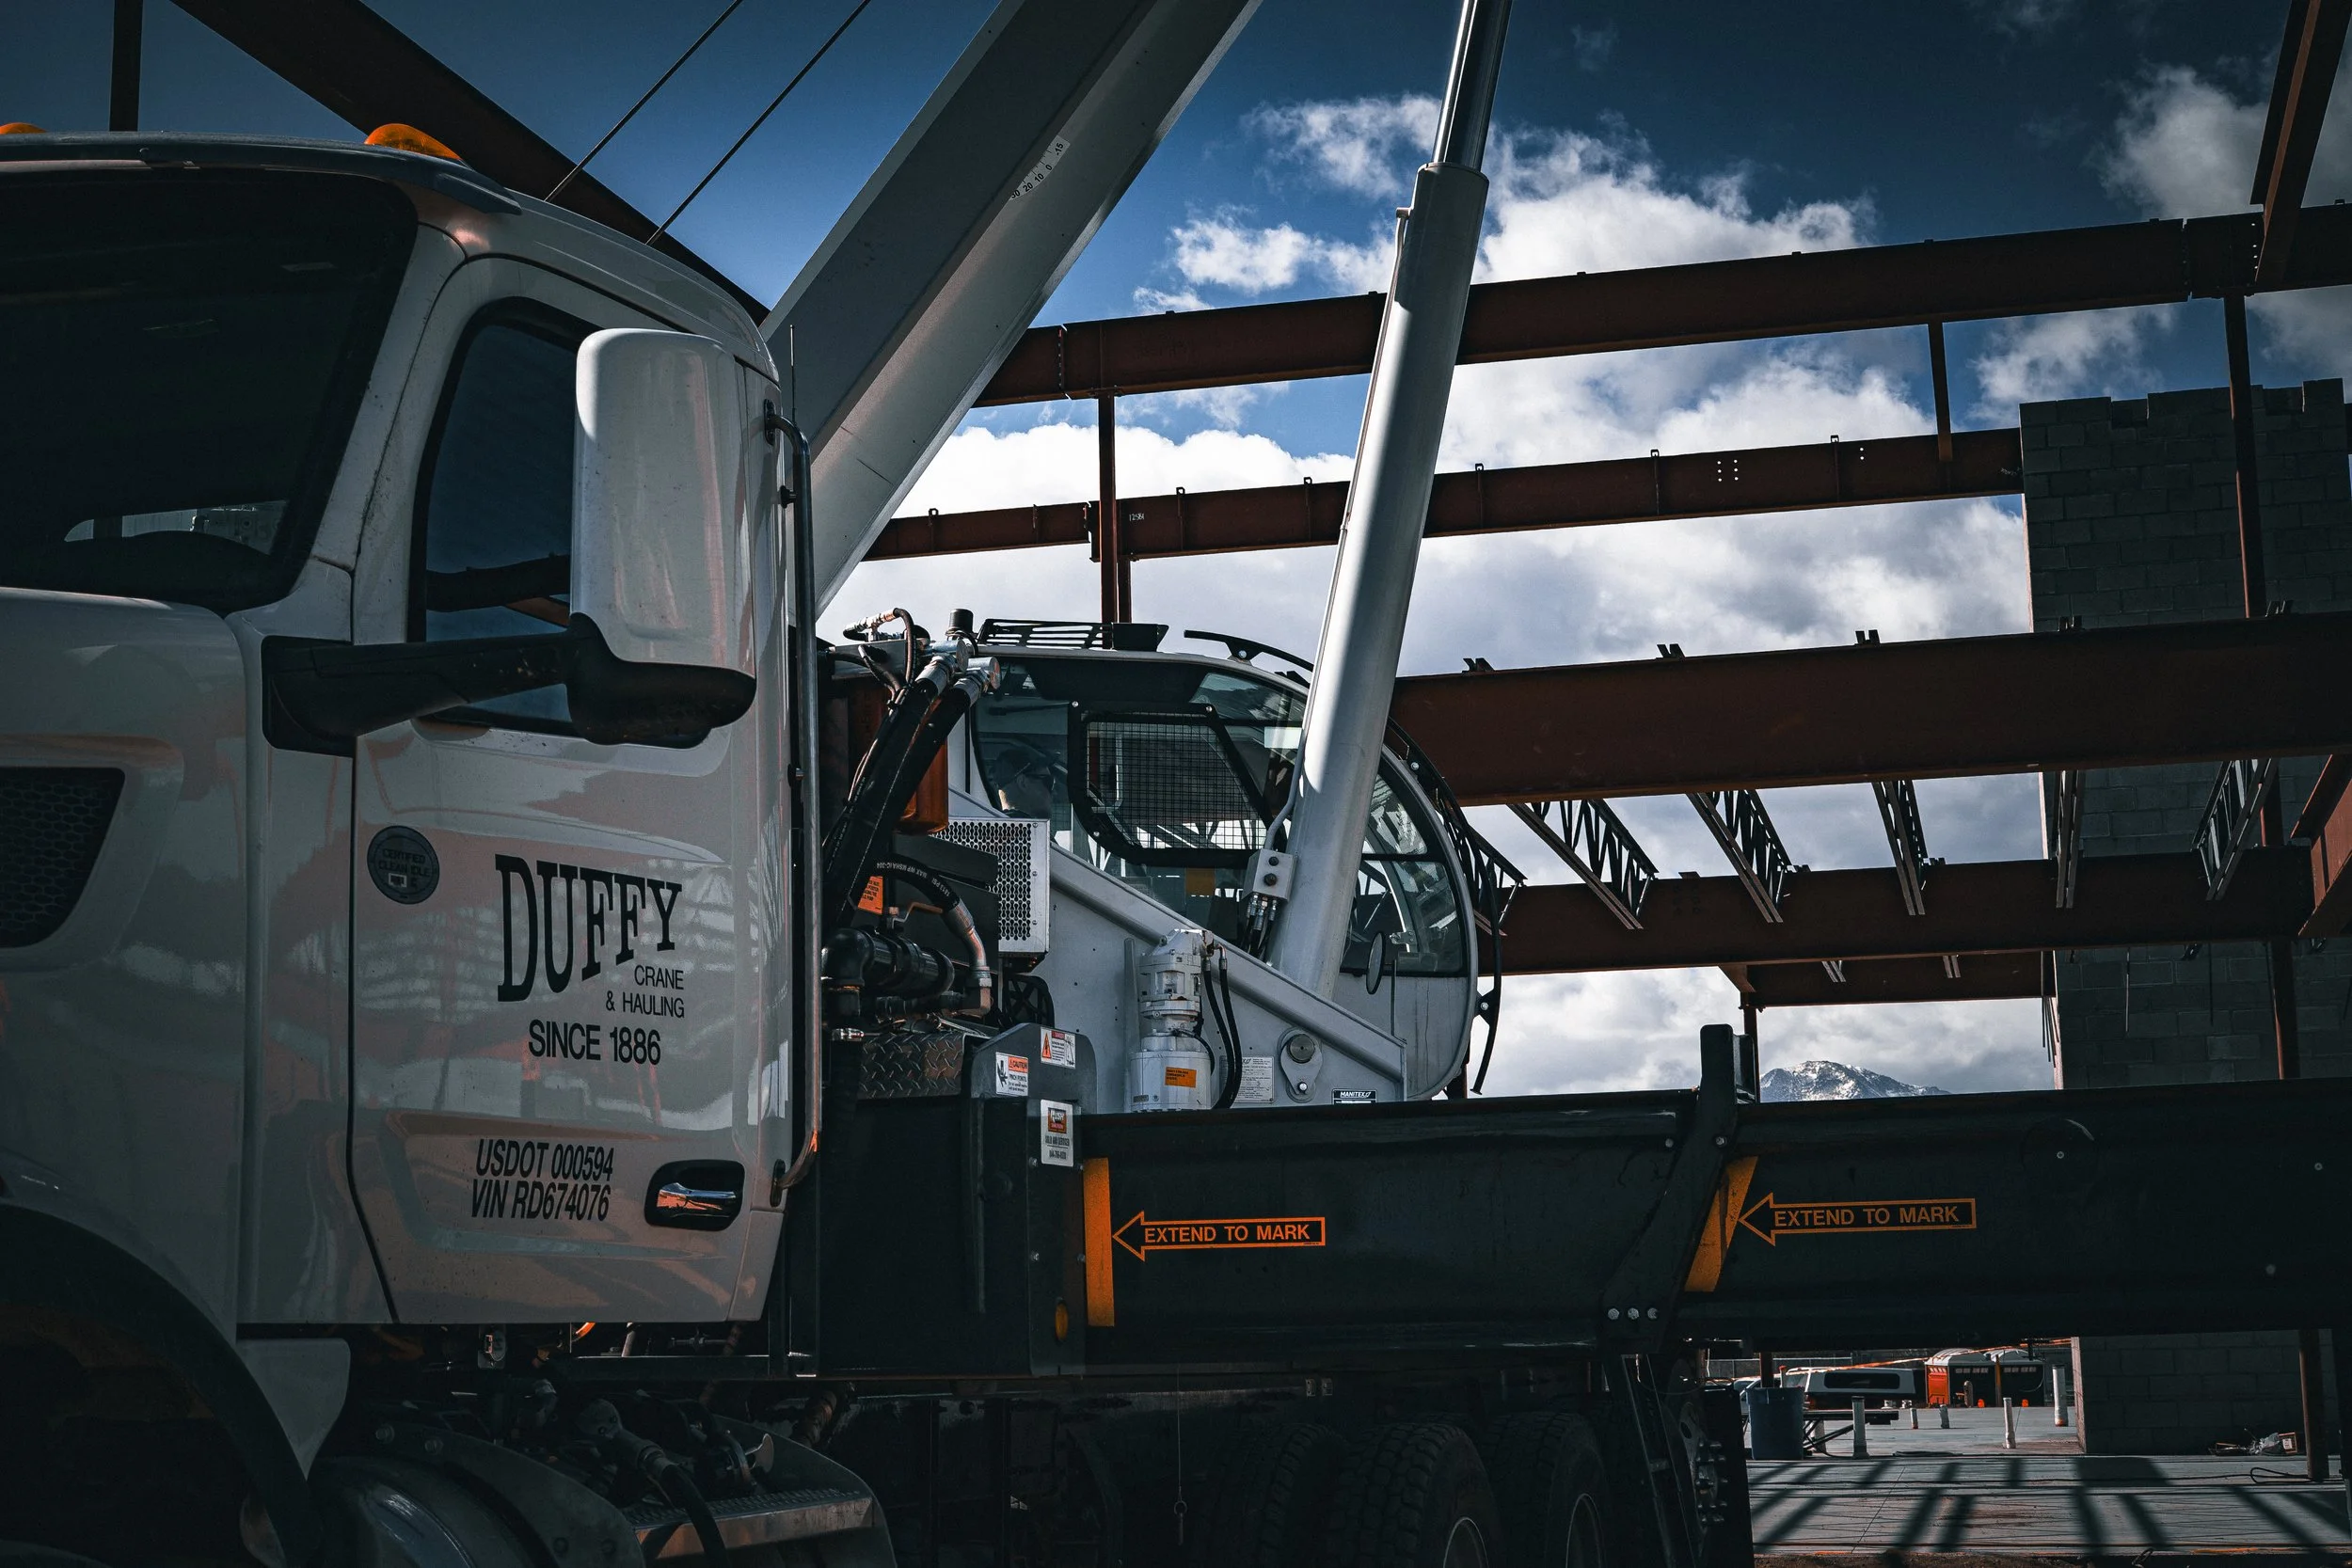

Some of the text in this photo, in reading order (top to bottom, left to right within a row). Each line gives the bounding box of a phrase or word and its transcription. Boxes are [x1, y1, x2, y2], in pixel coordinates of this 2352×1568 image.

[1023, 182, 1033, 192] 20
[1035, 173, 1044, 182] 10
[378, 860, 407, 874] CLEAN
[914, 868, 928, 879] MAX
[495, 854, 683, 1003] DUFFY
[634, 965, 684, 990] CRANE
[606, 990, 685, 1019] & HAULING
[529, 1019, 660, 1065] SINCE 1886
[1013, 1060, 1027, 1069] CAUTION
[475, 1139, 614, 1181] USDOT 000594
[471, 1180, 611, 1221] VIN RD674076
[1773, 1205, 1959, 1227] EXTEND TO MARK
[1144, 1224, 1311, 1243] EXTEND TO MARK
